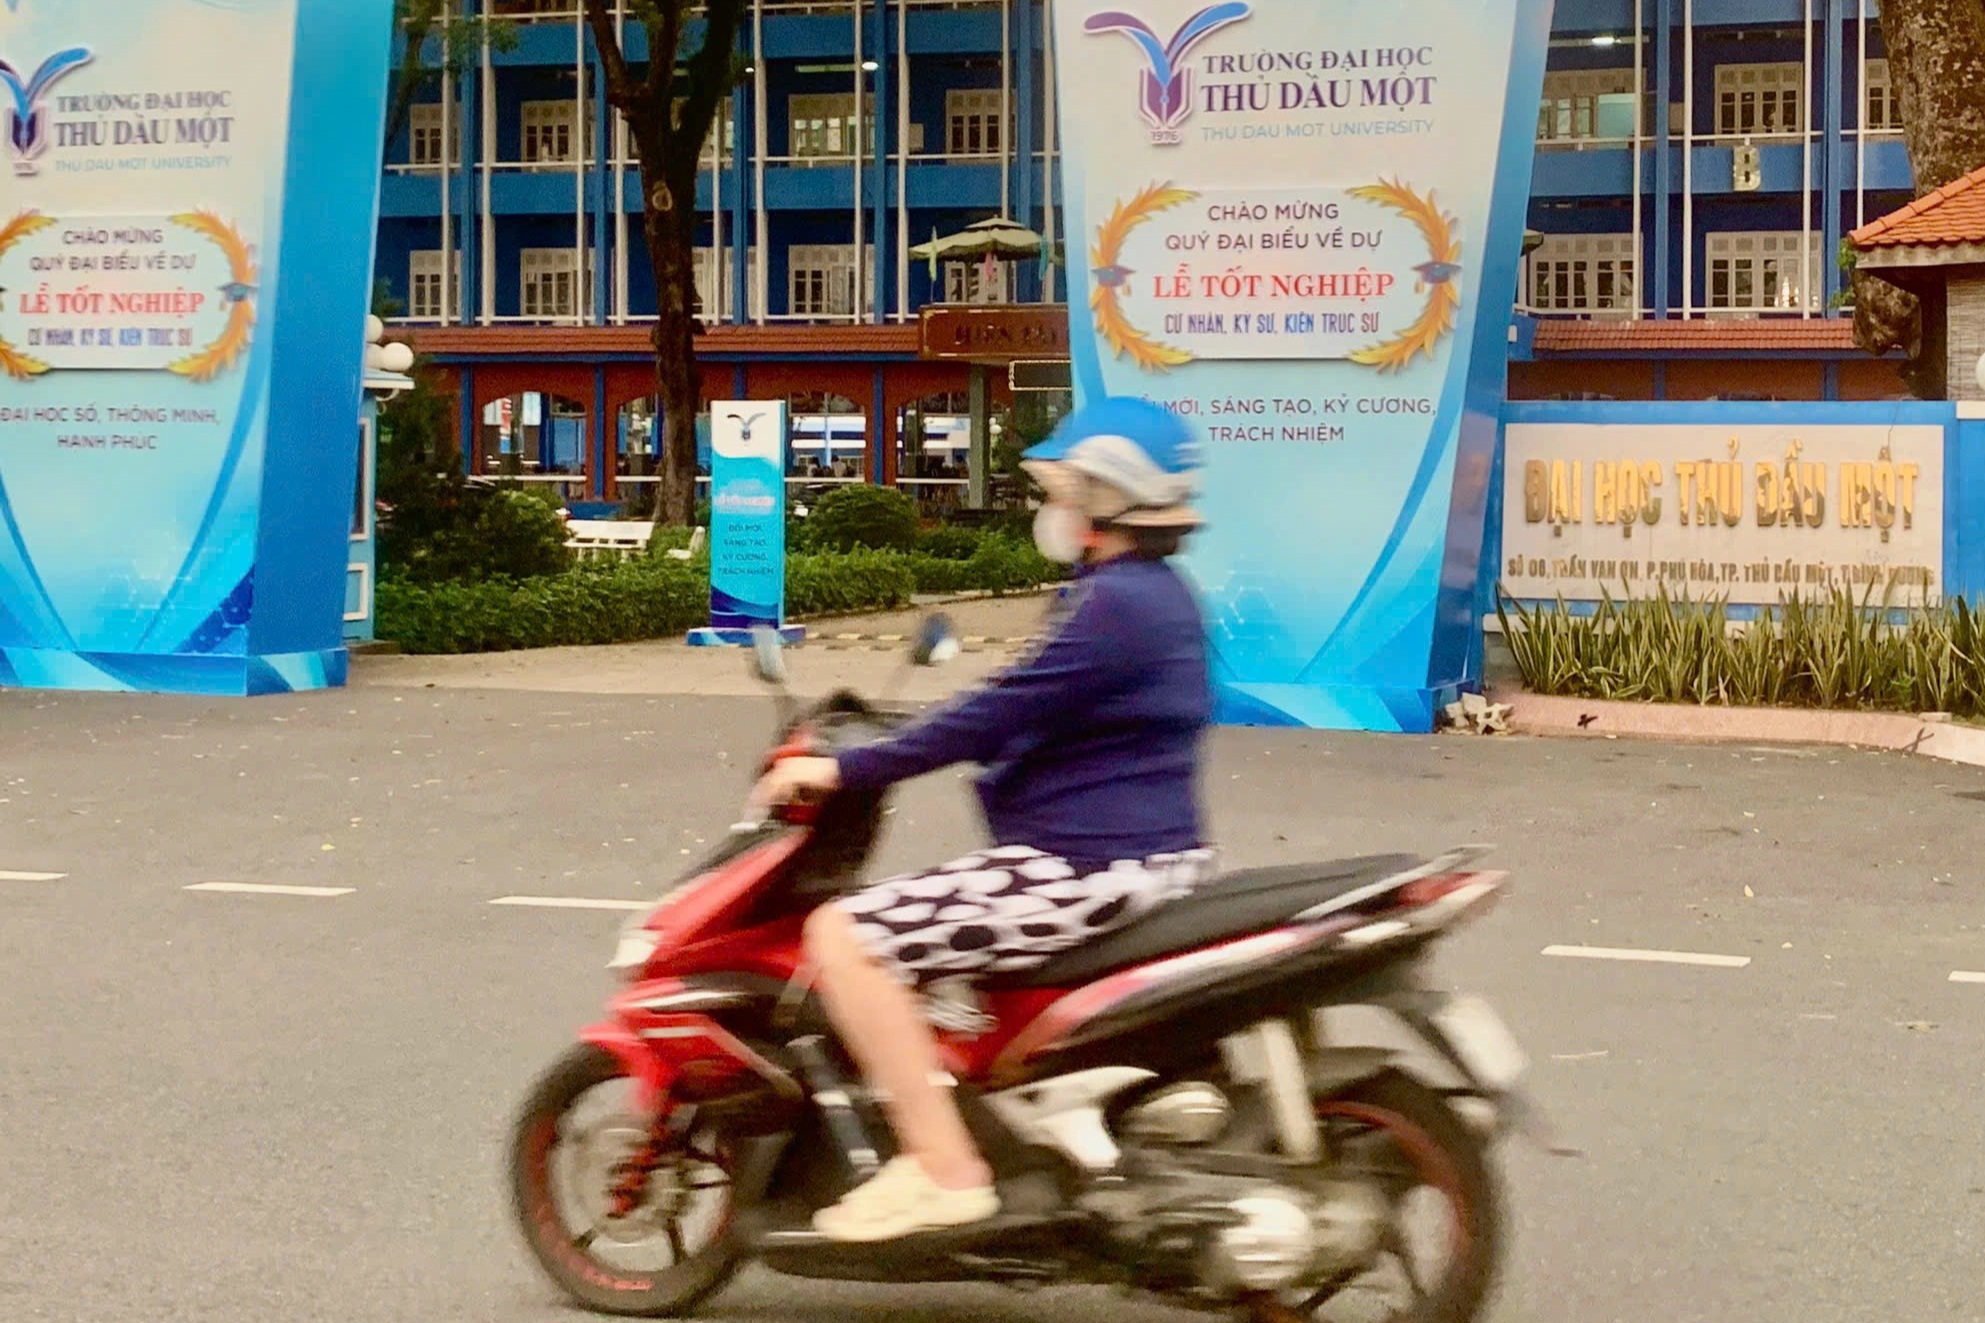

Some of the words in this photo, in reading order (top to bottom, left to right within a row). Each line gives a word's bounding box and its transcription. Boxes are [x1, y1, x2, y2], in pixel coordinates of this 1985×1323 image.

[1202, 49, 1312, 74] TRƯỜNG
[1320, 49, 1368, 72] ĐẠI
[1375, 46, 1433, 70] HỌC
[1201, 75, 1270, 112] THỦ
[1277, 72, 1352, 109] DẦU
[1359, 72, 1436, 112] MỘT
[54, 114, 108, 147] THỦ
[113, 113, 170, 145] DẦU
[174, 111, 235, 148] MỘT
[1201, 126, 1238, 141] THU
[1241, 125, 1280, 139] DAU
[1285, 122, 1325, 138] MOT
[1330, 118, 1435, 137] UNIVERSITY
[56, 160, 81, 172] THU
[85, 159, 114, 171] DAU
[119, 158, 146, 170] MOT
[151, 156, 232, 170] UNIVERSITY
[1208, 200, 1268, 221] CHÀO
[1275, 199, 1339, 220] MỪNG
[1165, 230, 1210, 250] QUÝ
[1217, 234, 1254, 254] ĐẠI
[1261, 225, 1309, 249] BIỂU
[1351, 229, 1383, 252] DỰ
[69, 256, 97, 273] ĐẠI
[1153, 263, 1191, 298] LỄ
[1200, 265, 1262, 298] TỐT
[1270, 266, 1395, 302] NGHIỆP
[19, 282, 49, 314] LỄ
[56, 285, 104, 314] TỐT
[110, 286, 205, 319] NGHIỆP
[107, 404, 167, 423] THÔNG
[1211, 395, 1265, 414] SÁNG
[1272, 398, 1317, 417] TẠO,
[1356, 396, 1437, 416] CƯƠNG,
[1208, 423, 1275, 441] TRÁCH
[1281, 422, 1345, 445] NHIỆM
[1525, 459, 1583, 537] ĐẠI
[1594, 459, 1662, 538] HỌC
[1675, 435, 1743, 527] THỦ
[1840, 446, 1918, 543] MỘT
